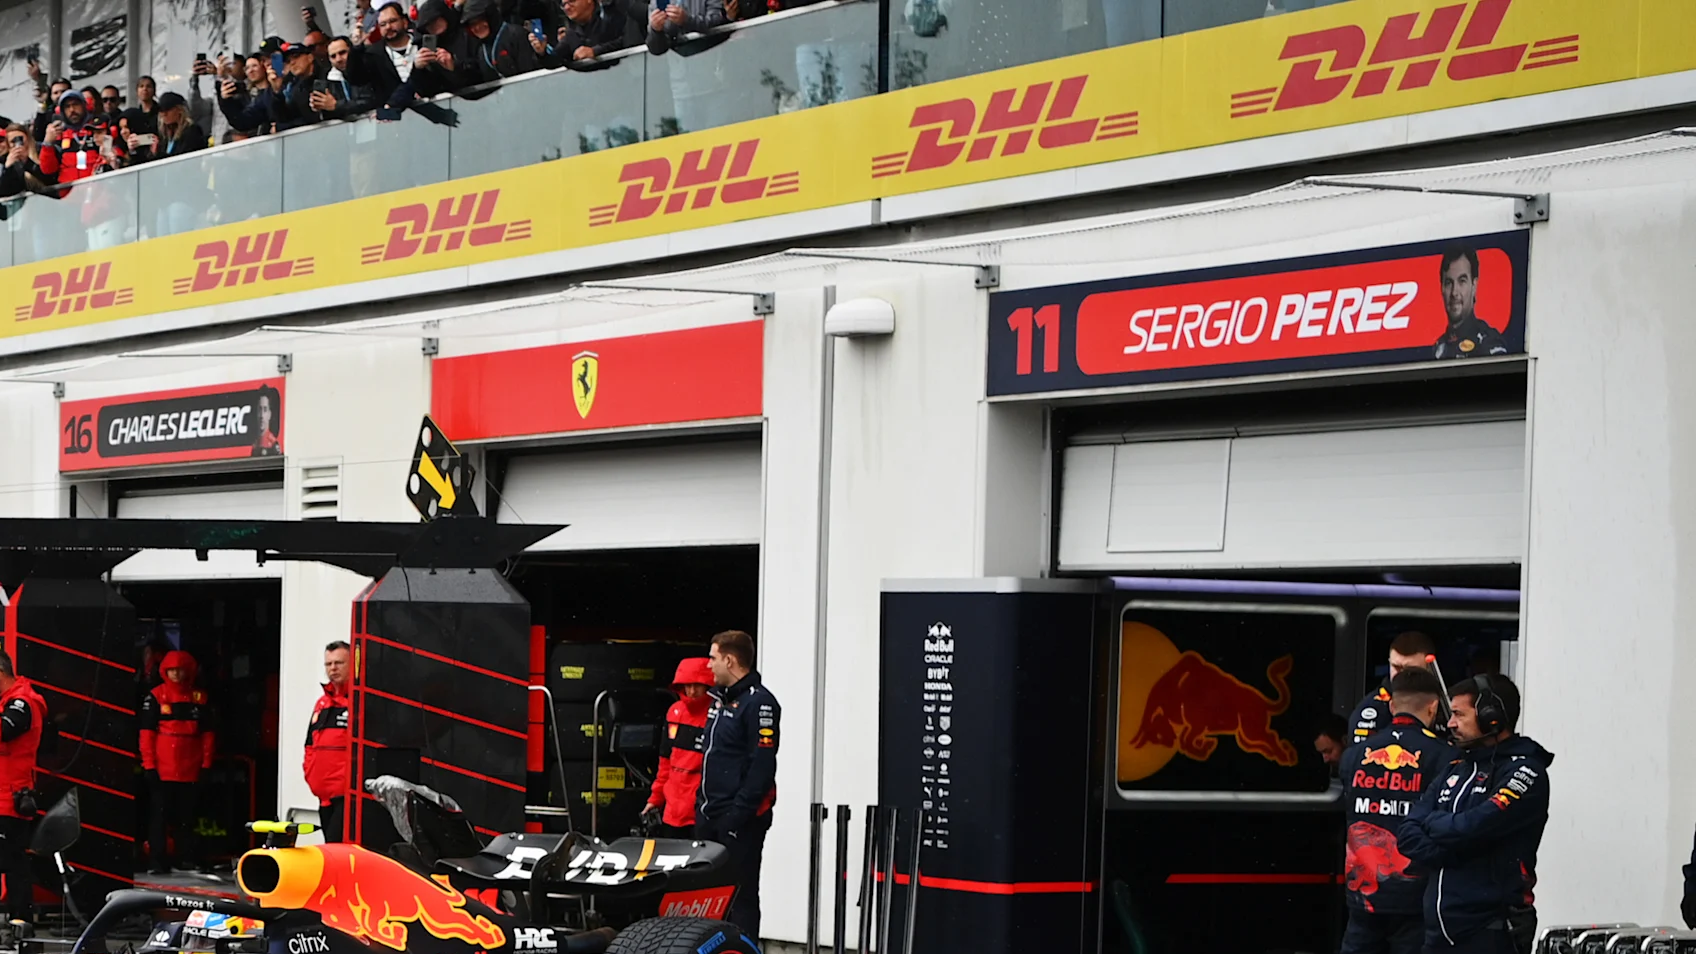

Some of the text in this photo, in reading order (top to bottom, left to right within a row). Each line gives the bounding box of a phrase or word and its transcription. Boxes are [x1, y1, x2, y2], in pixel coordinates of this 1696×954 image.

[1273, 0, 1525, 111] DHL
[906, 75, 1099, 172] DHL
[616, 139, 768, 222] DHL
[384, 189, 508, 261] DHL
[191, 229, 293, 292] DHL
[30, 262, 116, 321] DHL
[1007, 281, 1419, 376] 11 SERGIO PEREZ
[64, 404, 252, 454] 16 CHARLES LECLERC
[924, 654, 953, 664] ORACLE
[1355, 797, 1397, 816] Mobil
[175, 897, 204, 908] Tezos
[665, 897, 709, 917] Mobil
[288, 932, 330, 954] citrix
[513, 928, 558, 949] HRC
